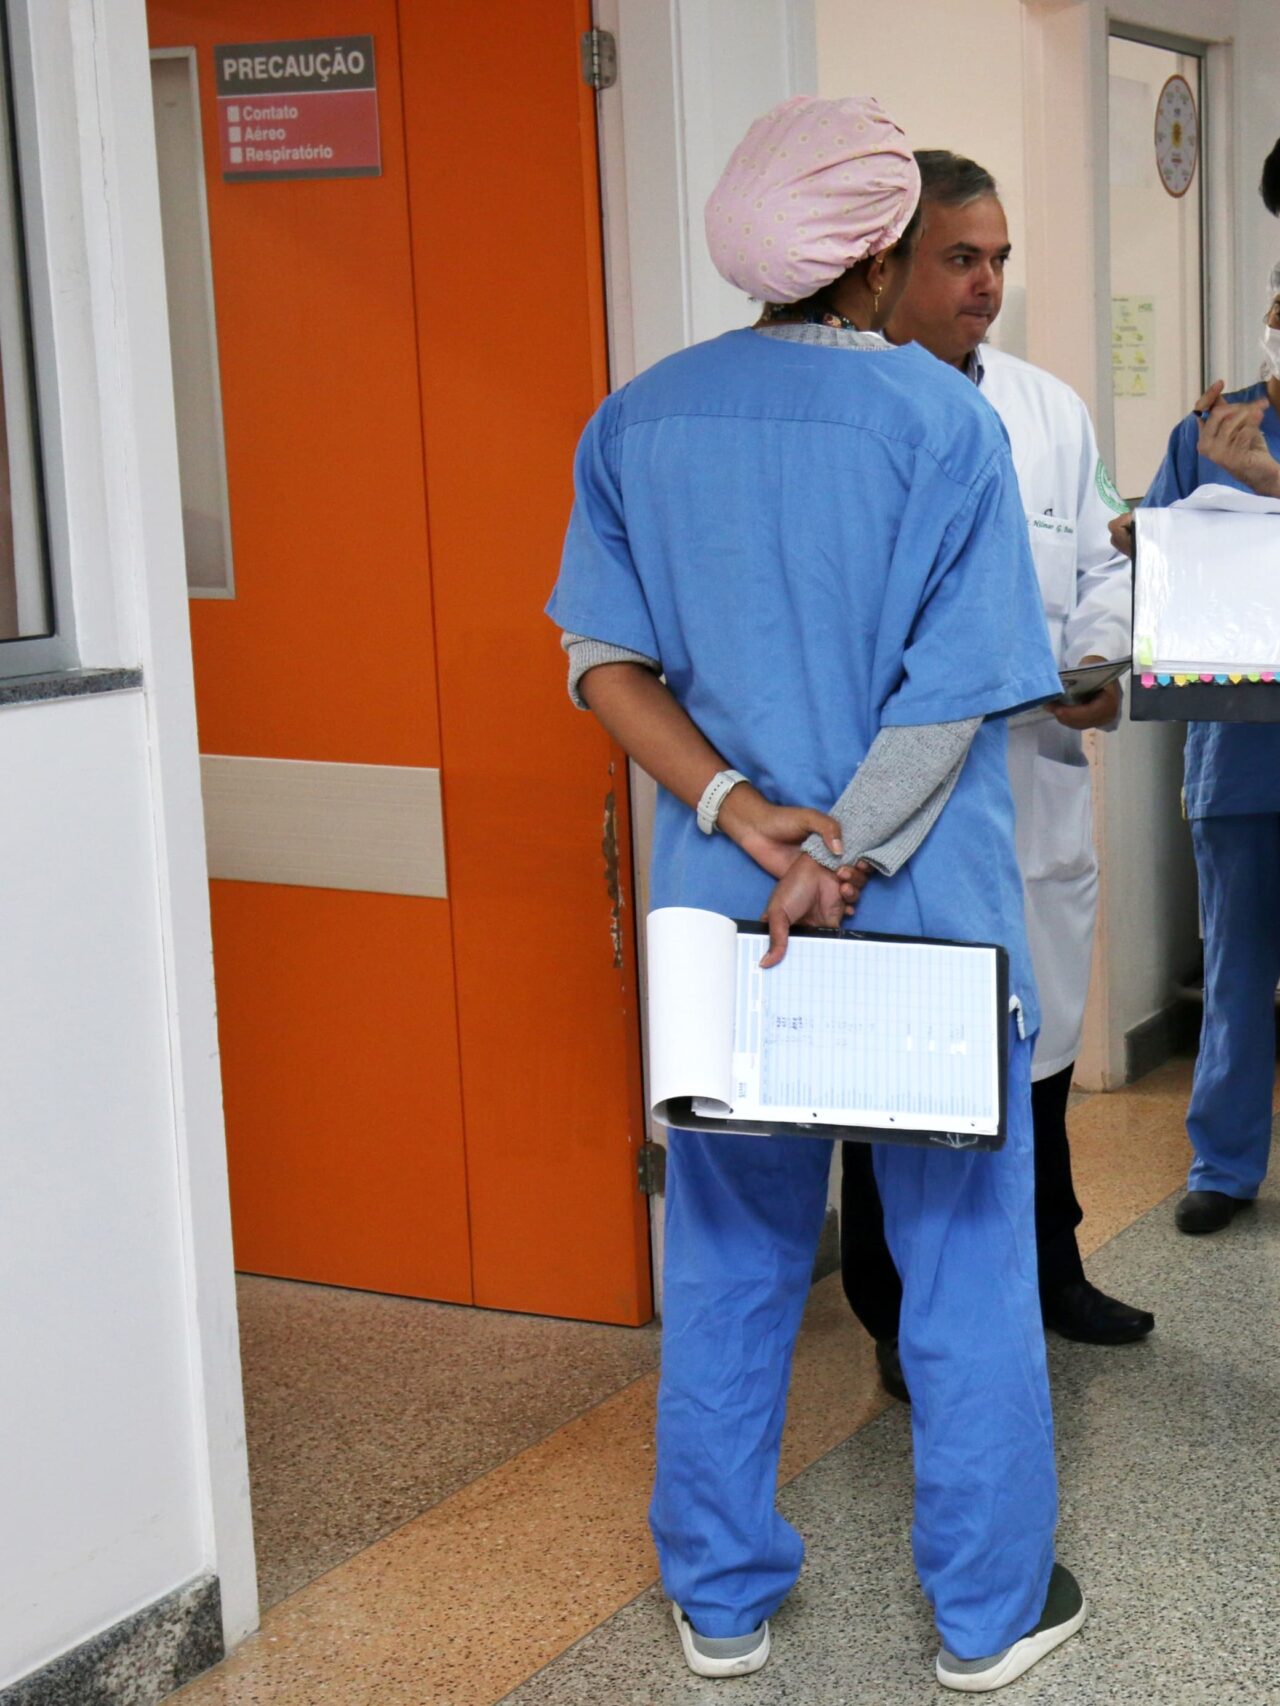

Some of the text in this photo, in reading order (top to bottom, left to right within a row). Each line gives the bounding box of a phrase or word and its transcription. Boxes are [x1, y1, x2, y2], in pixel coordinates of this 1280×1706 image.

[223, 47, 365, 82] PRECAUÇÃO
[243, 105, 298, 121] Contato
[244, 126, 286, 142] Aéreo
[246, 144, 333, 164] Respiratório
